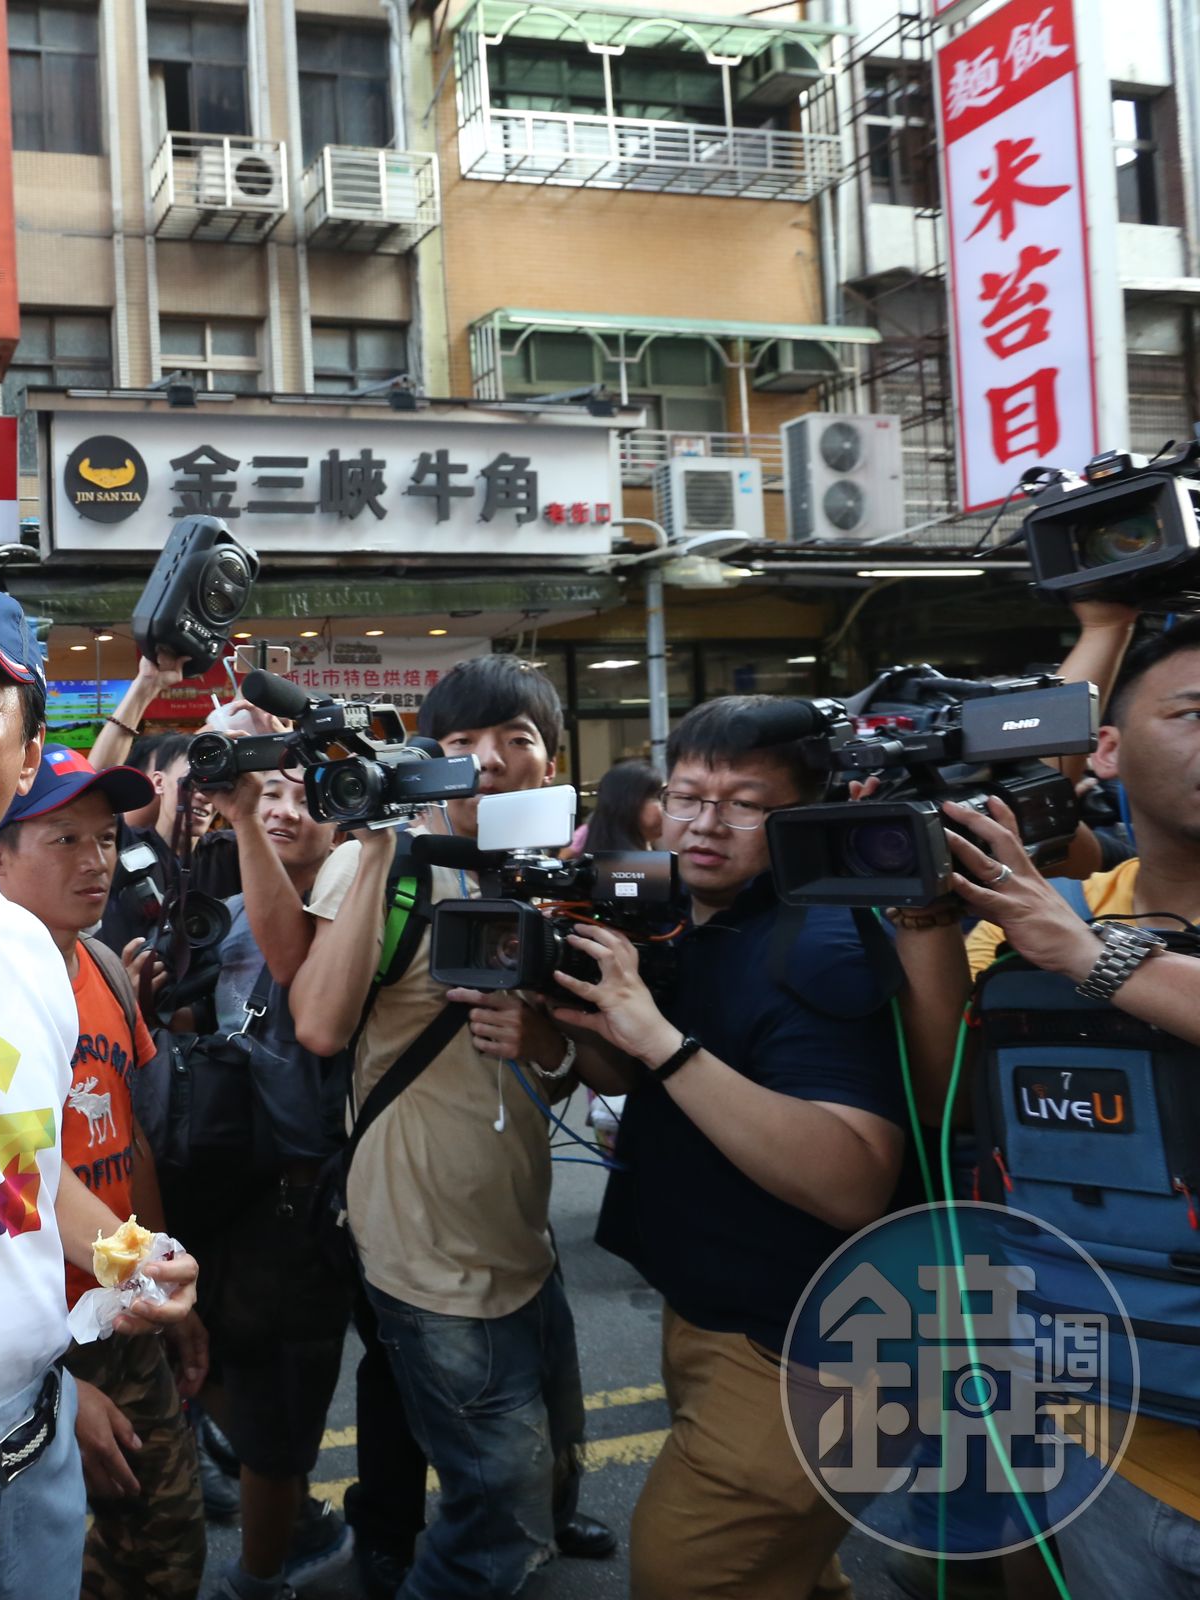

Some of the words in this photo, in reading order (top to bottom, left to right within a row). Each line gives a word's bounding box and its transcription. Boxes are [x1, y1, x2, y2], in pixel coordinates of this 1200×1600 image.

[964, 137, 1072, 464] 米苔目
[75, 491, 94, 504] JIN
[96, 491, 119, 502] SAN
[120, 491, 141, 503] XIA
[170, 444, 538, 525] 金三峽牛角
[1061, 1071, 1073, 1090] 7
